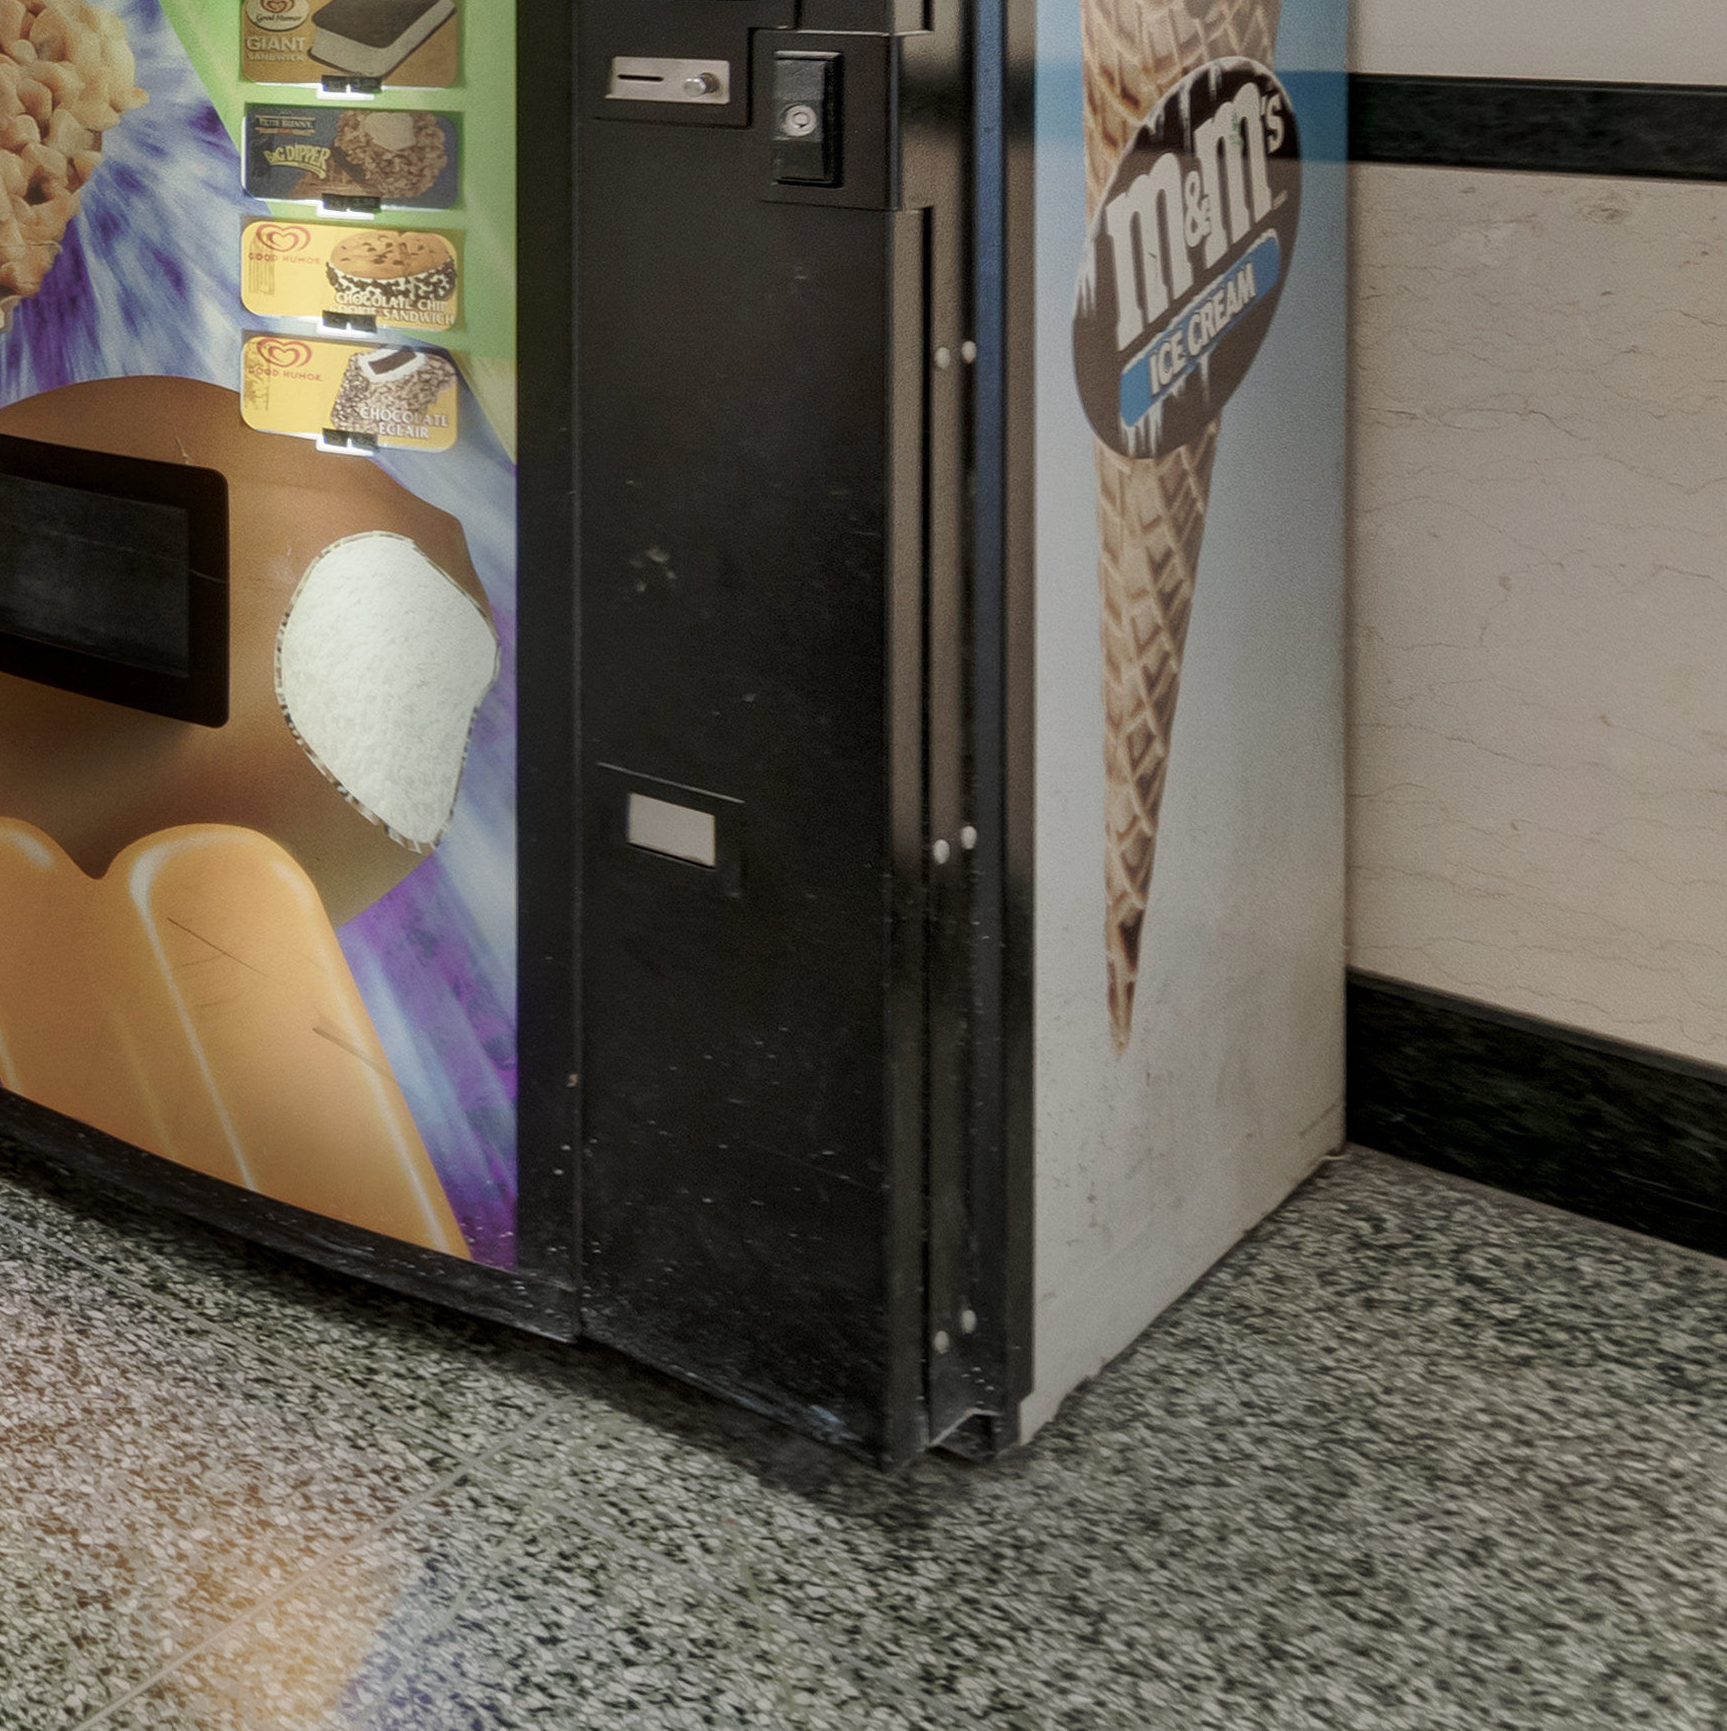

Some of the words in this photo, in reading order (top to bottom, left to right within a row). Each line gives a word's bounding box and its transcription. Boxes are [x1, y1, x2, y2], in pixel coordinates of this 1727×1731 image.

[246, 36, 307, 52] GIANT
[285, 143, 331, 171] DIPPER
[248, 252, 275, 262] GOOD
[335, 291, 414, 310] CHOCOLATE
[417, 298, 448, 312] CHIP
[382, 308, 455, 325] SANDWICH
[1149, 332, 1187, 394] ICE
[1187, 261, 1257, 357] CREAM
[248, 366, 280, 377] GOOD
[360, 406, 449, 427] CHOCOLATE
[378, 420, 429, 439] ECLAIR
